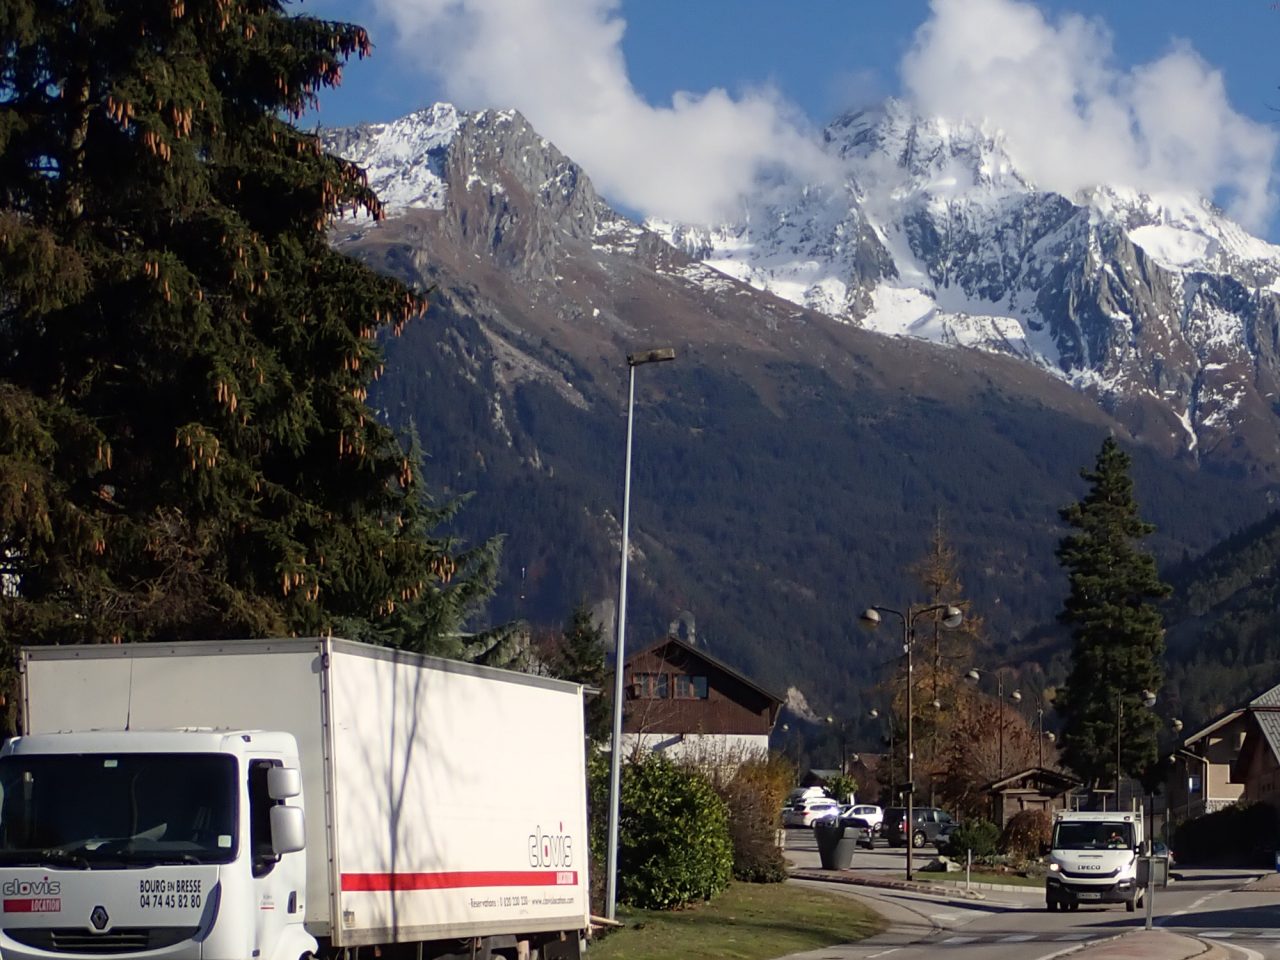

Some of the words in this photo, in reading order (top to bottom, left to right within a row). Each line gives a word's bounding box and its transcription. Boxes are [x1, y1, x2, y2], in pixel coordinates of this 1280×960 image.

[528, 820, 573, 868] clovis
[2, 876, 61, 896] clovis
[140, 879, 166, 893] BOURG
[167, 882, 175, 892] EN
[176, 879, 201, 893] BRESSE
[31, 898, 60, 912] LOCATION
[140, 894, 150, 908] 04
[152, 894, 163, 908] 74
[165, 894, 176, 908] 45
[177, 894, 188, 908] 82
[190, 894, 201, 908] 80
